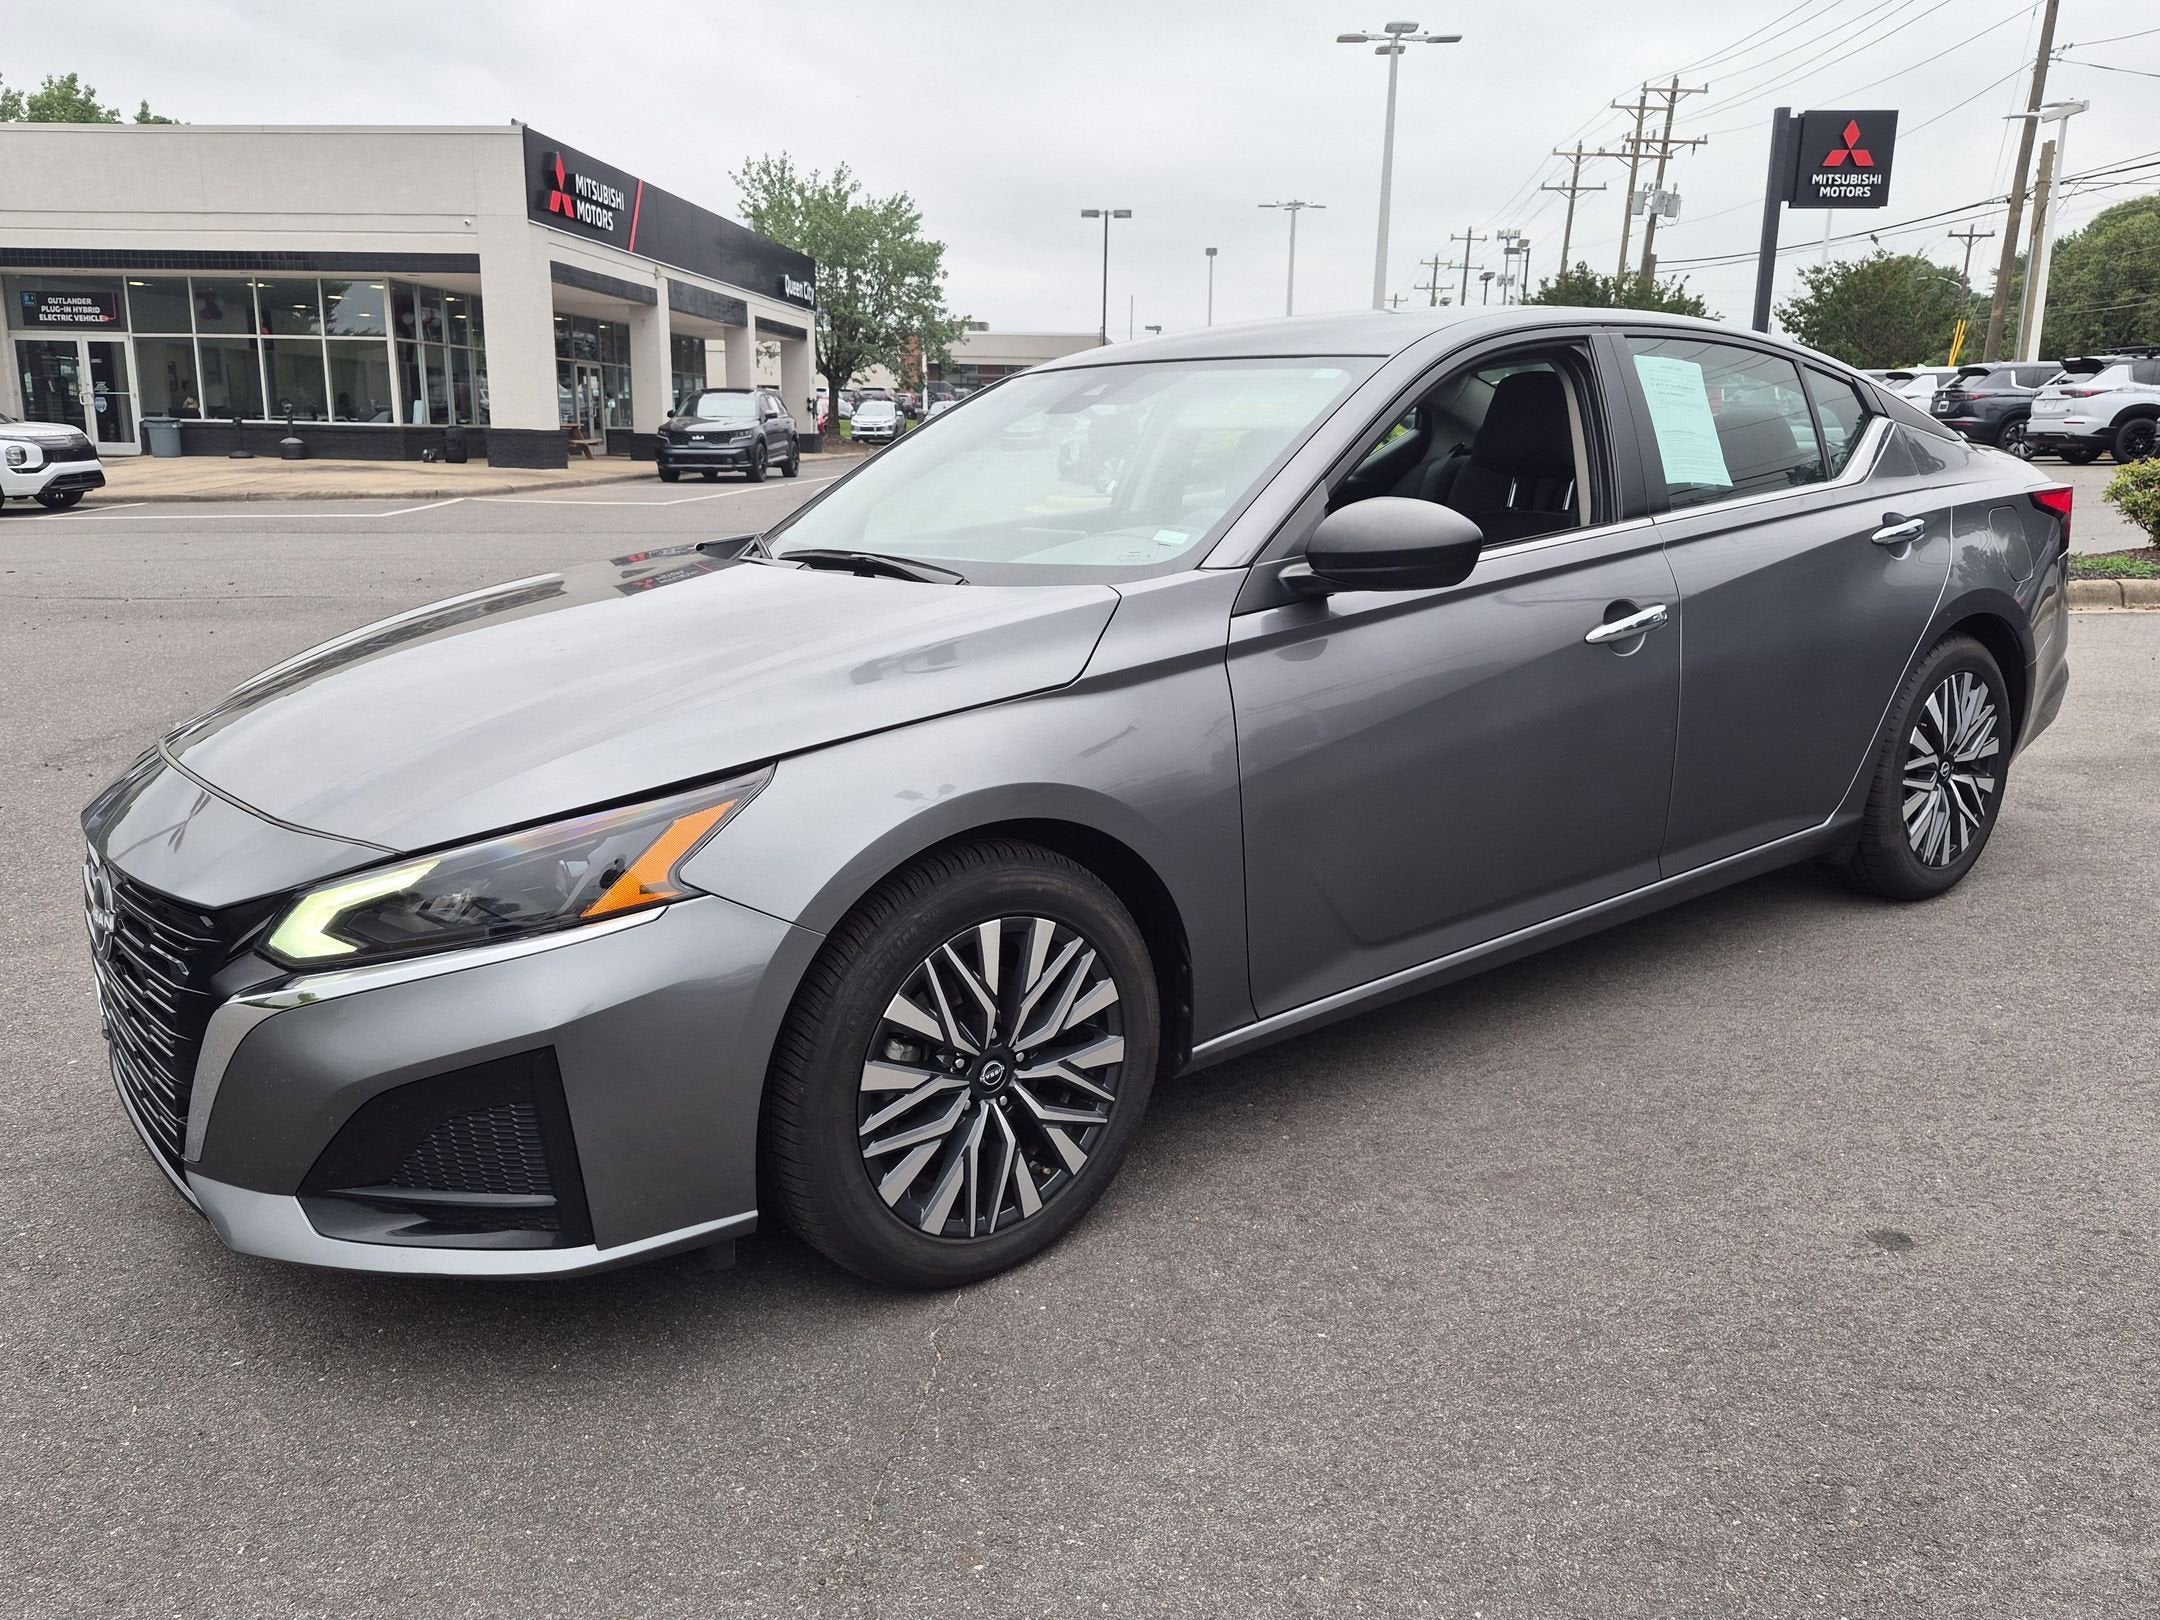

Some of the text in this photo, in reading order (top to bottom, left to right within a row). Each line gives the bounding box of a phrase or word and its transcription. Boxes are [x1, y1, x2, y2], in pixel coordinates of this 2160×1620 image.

[1811, 173, 1882, 185] MITSUBISHI
[575, 173, 625, 211] MITSUBISHI
[1819, 186, 1871, 197] MOTORS
[576, 199, 614, 231] MOTORS
[784, 274, 804, 299] Queen
[47, 297, 92, 305] OUTLANDER
[40, 305, 101, 314] PLUG-IN HYBRID
[39, 313, 104, 322] ELECTRIC VEHICLE
